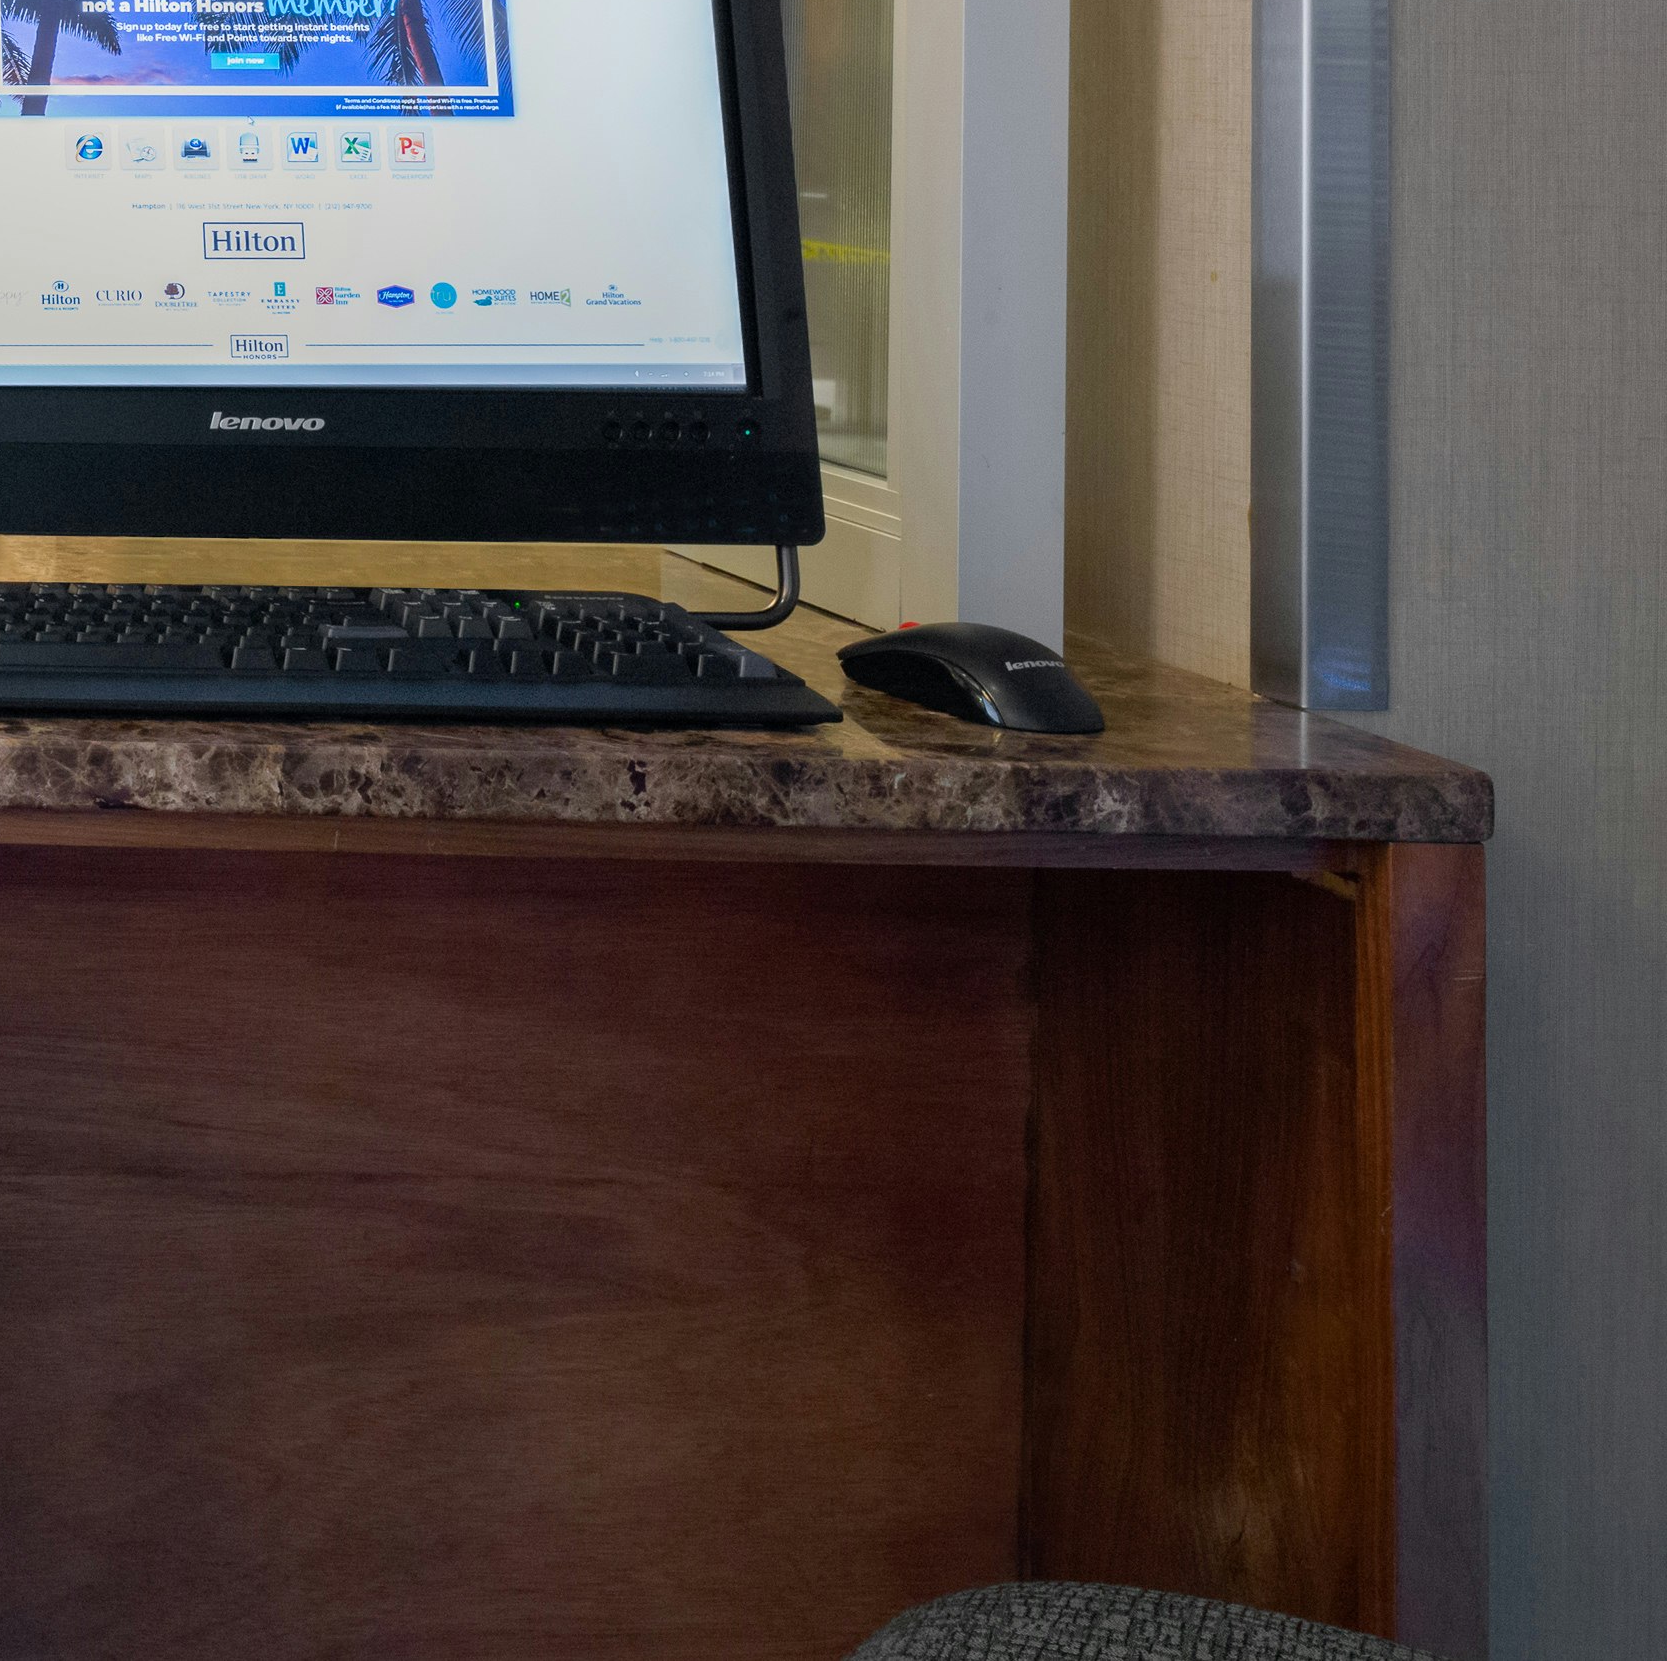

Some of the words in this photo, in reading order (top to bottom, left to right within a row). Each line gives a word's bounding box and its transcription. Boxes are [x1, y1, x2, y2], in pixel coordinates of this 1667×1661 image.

[119, 0, 131, 13] a
[116, 22, 139, 32] Sign
[139, 24, 153, 32] up
[154, 23, 183, 33] today
[183, 22, 198, 31] for
[200, 22, 220, 31] free
[220, 23, 231, 31] to
[233, 23, 256, 31] start
[258, 23, 293, 33] getting
[294, 22, 329, 31] instant
[330, 22, 370, 32] benefits
[137, 34, 154, 42] like
[155, 34, 178, 42] Free
[179, 34, 206, 42] Wi-Fi
[207, 34, 226, 42] and
[226, 34, 258, 42] Points
[259, 34, 297, 42] towards
[299, 34, 319, 42] free
[320, 34, 353, 44] nights.
[212, 230, 297, 253] Hilton
[41, 293, 81, 306] Hilton
[96, 289, 143, 302] CURIO
[379, 291, 413, 301] Hampton
[602, 291, 625, 299] Hilton
[235, 338, 284, 353] Hilton
[210, 410, 326, 433] lenovo
[1004, 660, 1065, 672] lenovo
